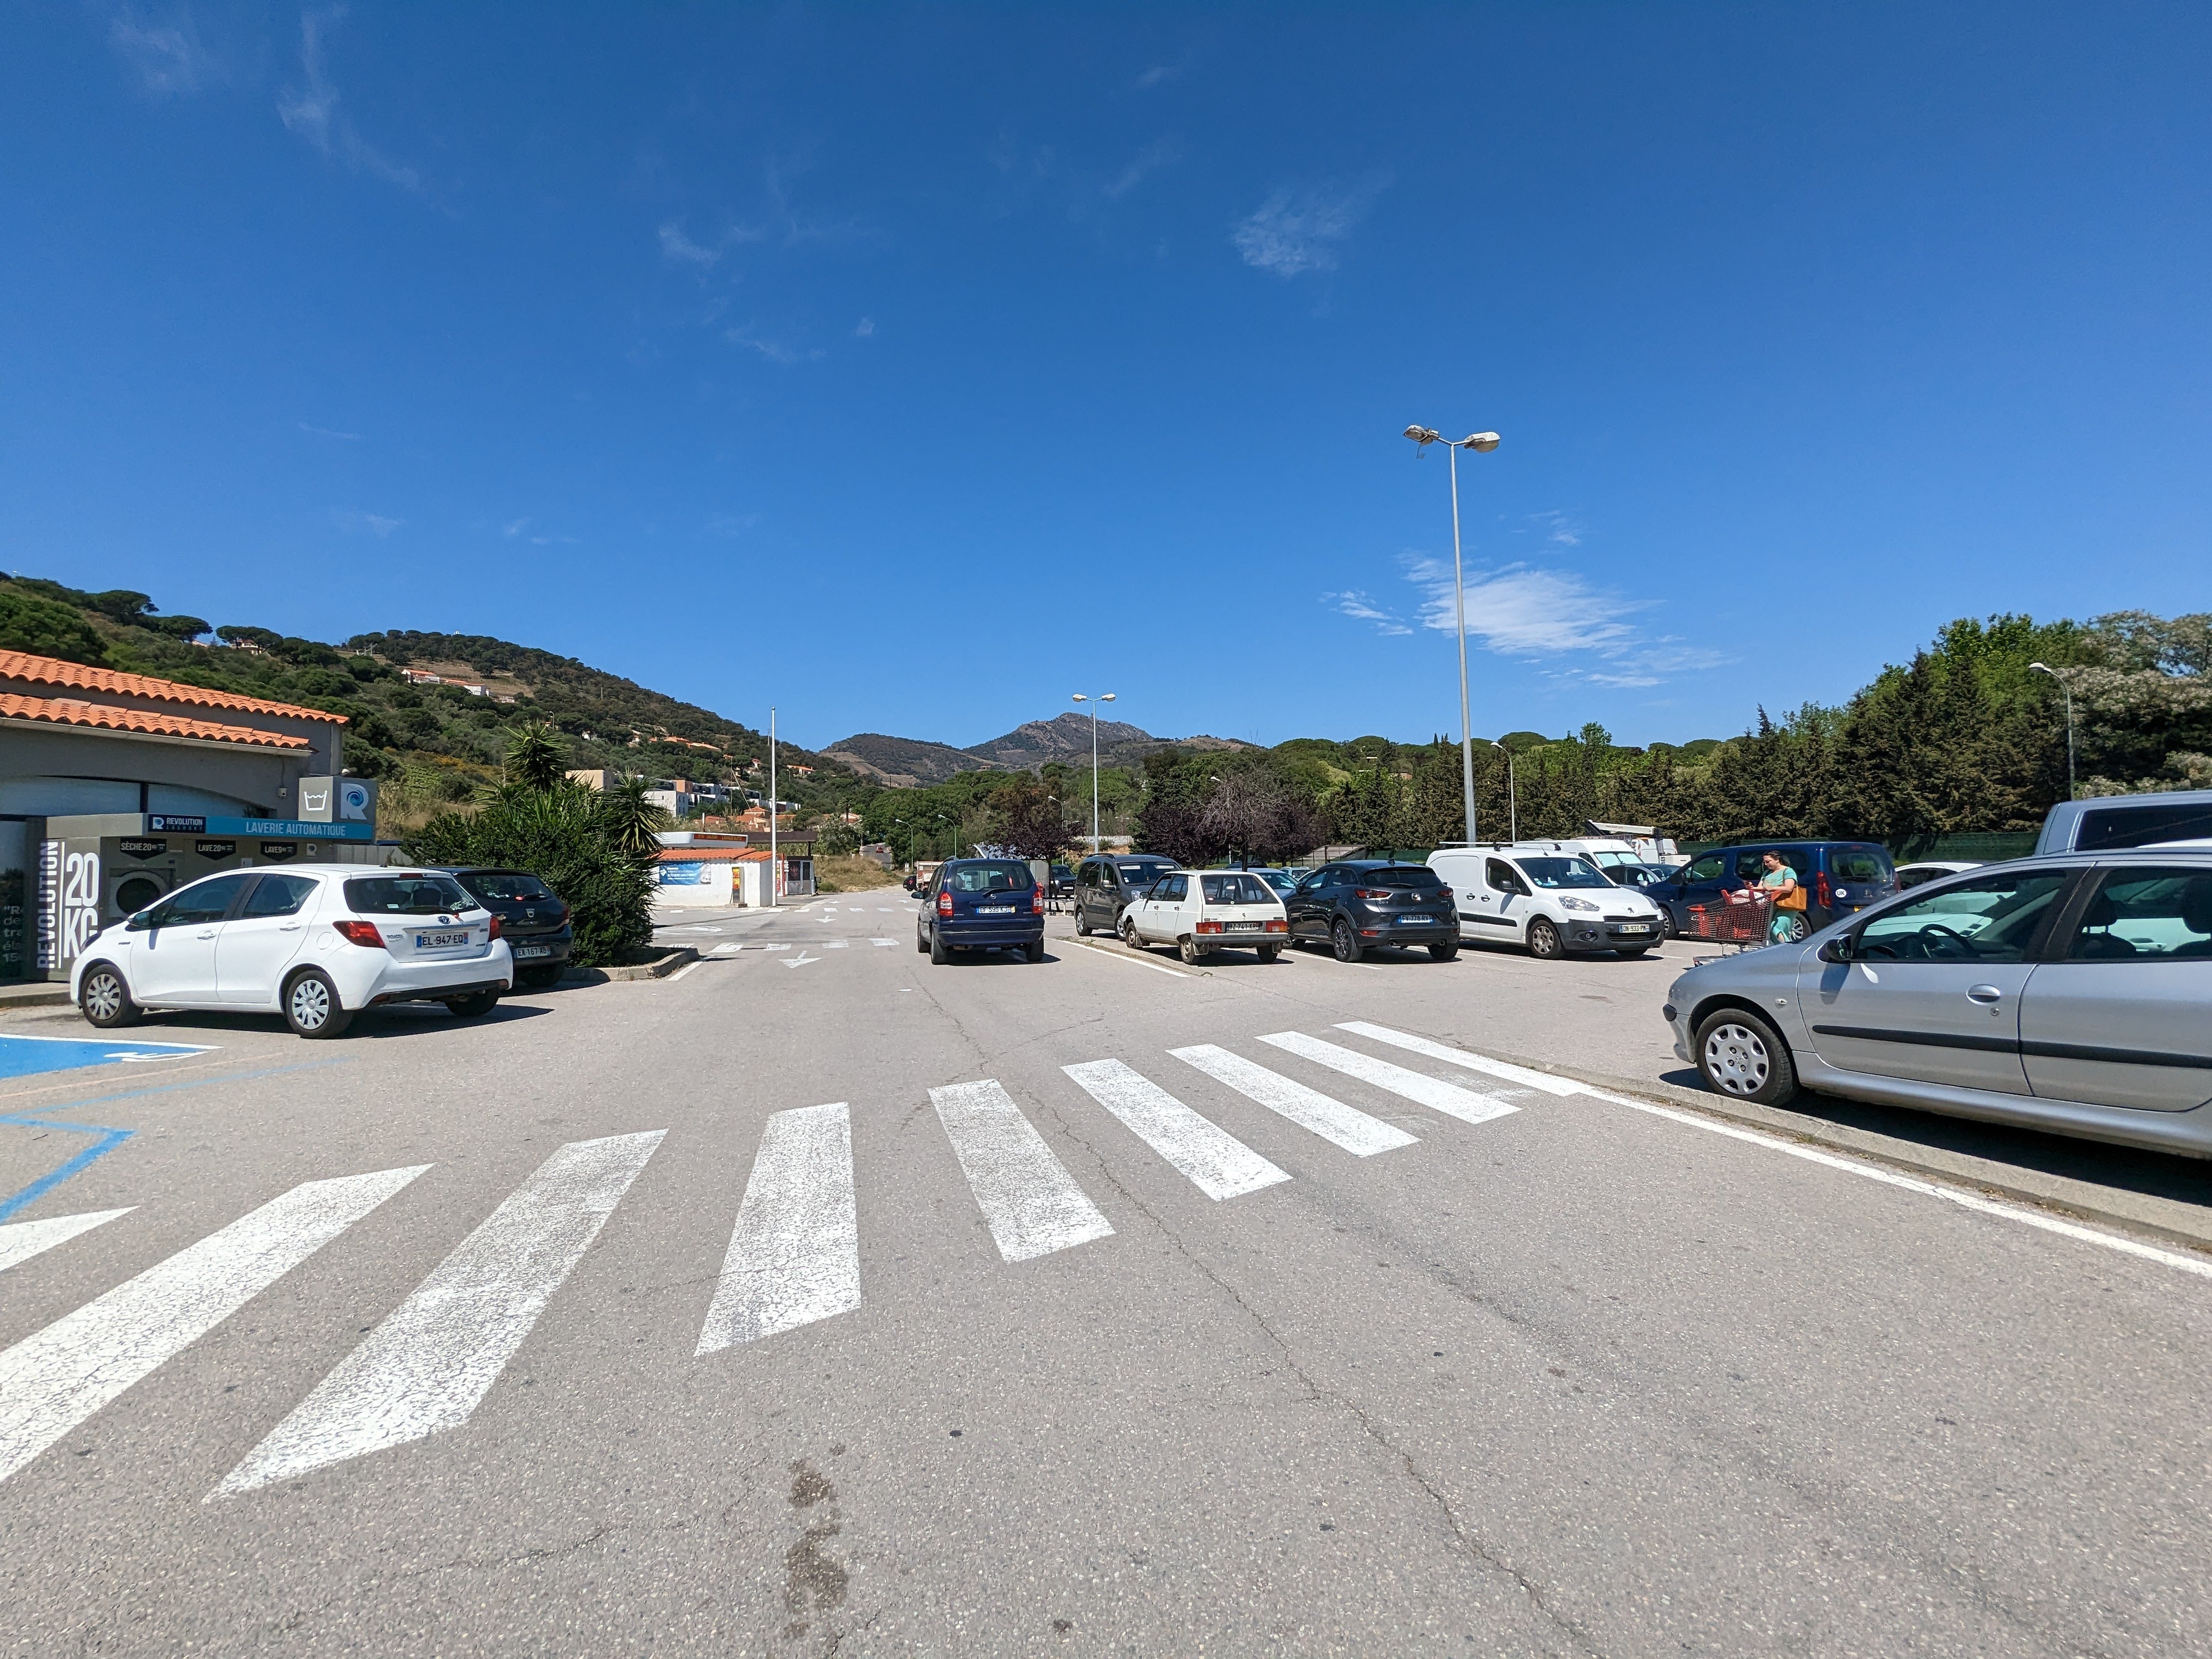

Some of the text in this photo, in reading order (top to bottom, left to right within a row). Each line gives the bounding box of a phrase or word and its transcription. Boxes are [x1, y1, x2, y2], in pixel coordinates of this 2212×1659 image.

[166, 817, 203, 826] REVOLUTION
[246, 822, 346, 836] LAVERIE AUTOMATIQUE
[65, 852, 100, 907] 20
[37, 842, 58, 969] REVOLUTION
[64, 907, 98, 958] KG
[422, 934, 464, 946] EL-947-EQ
